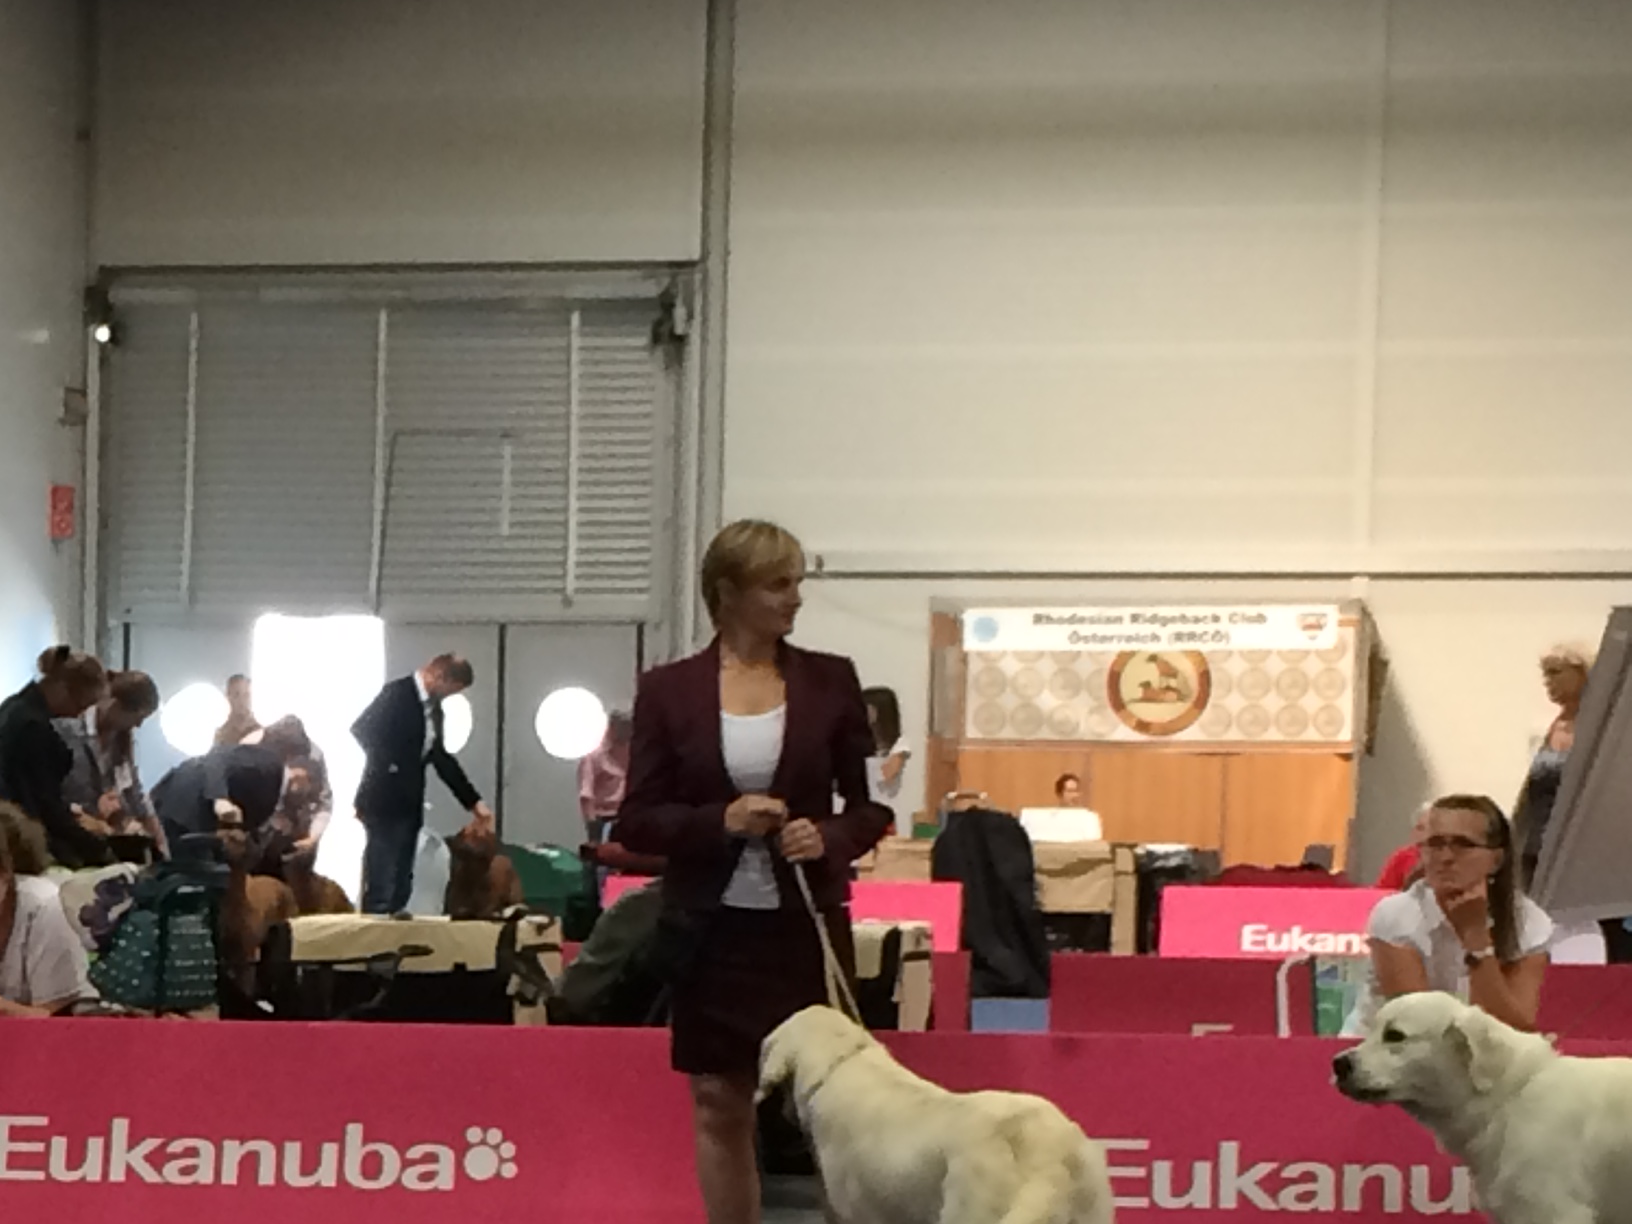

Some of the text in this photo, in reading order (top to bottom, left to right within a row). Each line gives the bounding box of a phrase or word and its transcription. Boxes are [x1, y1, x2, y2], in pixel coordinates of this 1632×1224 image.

[1032, 611, 1268, 627] Rhodesian Ridgeback Club
[1096, 1137, 1472, 1215] Eukanu
